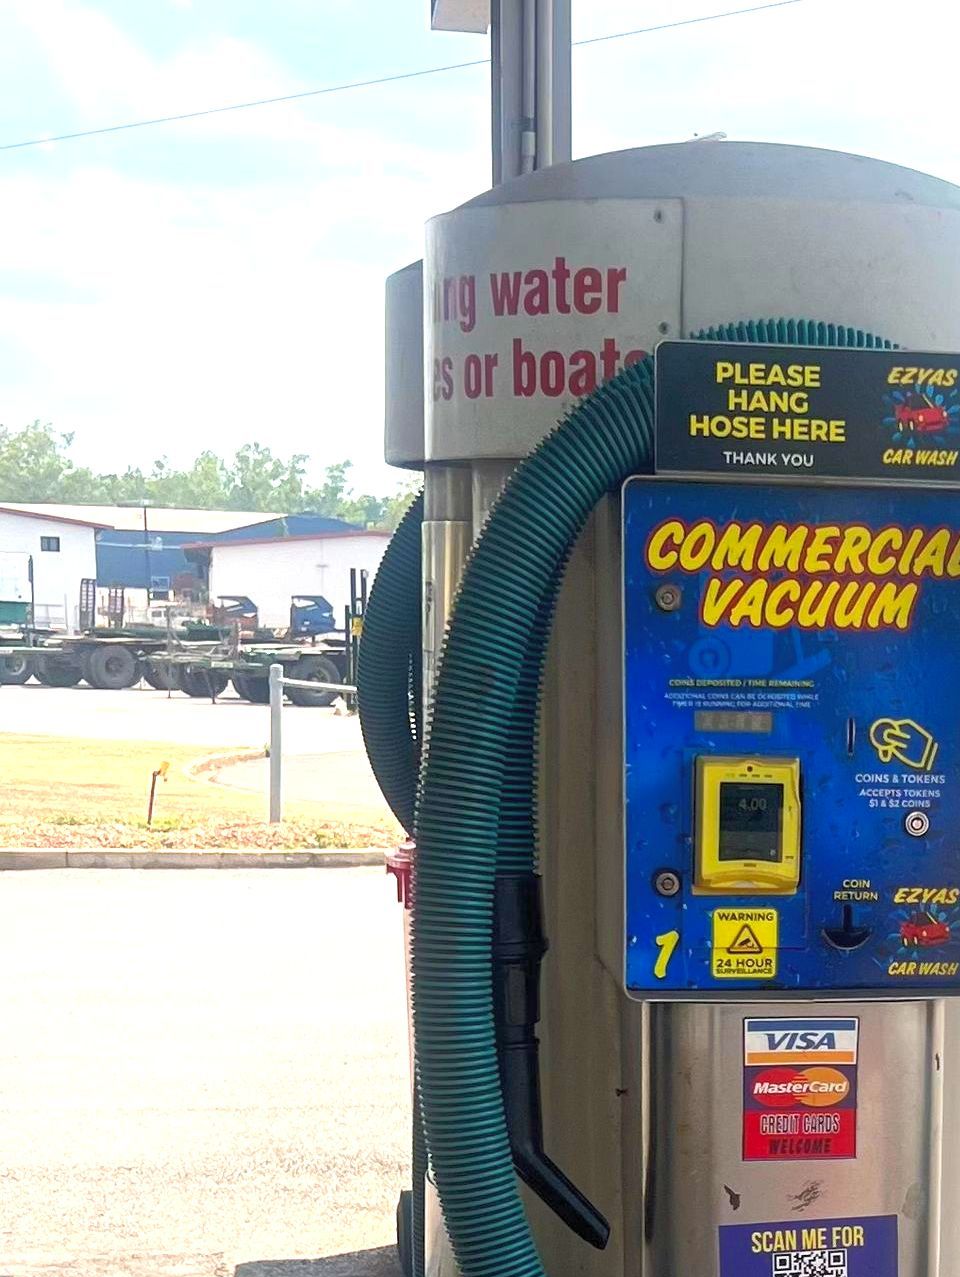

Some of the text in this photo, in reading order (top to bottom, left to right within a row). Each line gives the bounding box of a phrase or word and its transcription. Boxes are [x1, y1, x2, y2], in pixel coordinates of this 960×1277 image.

[489, 256, 627, 317] water
[464, 352, 499, 399] or
[512, 337, 650, 398] boat
[715, 362, 821, 388] PLEASE
[887, 366, 959, 387] EZYAS
[727, 389, 809, 414] HANG
[689, 415, 847, 443] HOSE HERE
[723, 451, 815, 468] THANK YOU
[882, 448, 960, 466] CAR WASH
[701, 578, 919, 630] VACUUM
[668, 679, 695, 688] COINS
[696, 680, 742, 688] DEPOSITED
[748, 680, 767, 688] TIME
[768, 680, 815, 688] REMAINING
[855, 774, 946, 784] COINS & TOKENS
[859, 789, 941, 798] ACCEPTS TOKENS
[738, 798, 767, 811] 4.00
[869, 798, 931, 808] $1 & $2 COINS
[843, 879, 871, 888] COIN
[834, 891, 878, 901] RETURN
[893, 887, 960, 904] EZYAS
[717, 912, 774, 921] WARNING
[654, 930, 680, 978] 1
[716, 958, 773, 968] 24 HOUR
[888, 962, 960, 976] CAR WASH
[765, 1032, 837, 1051] VISA
[753, 1080, 848, 1094] MasterCard
[761, 1113, 840, 1135] CREDIT CARDS
[768, 1138, 833, 1155] WELCOME
[751, 1225, 865, 1253] SCAN ME FOR
